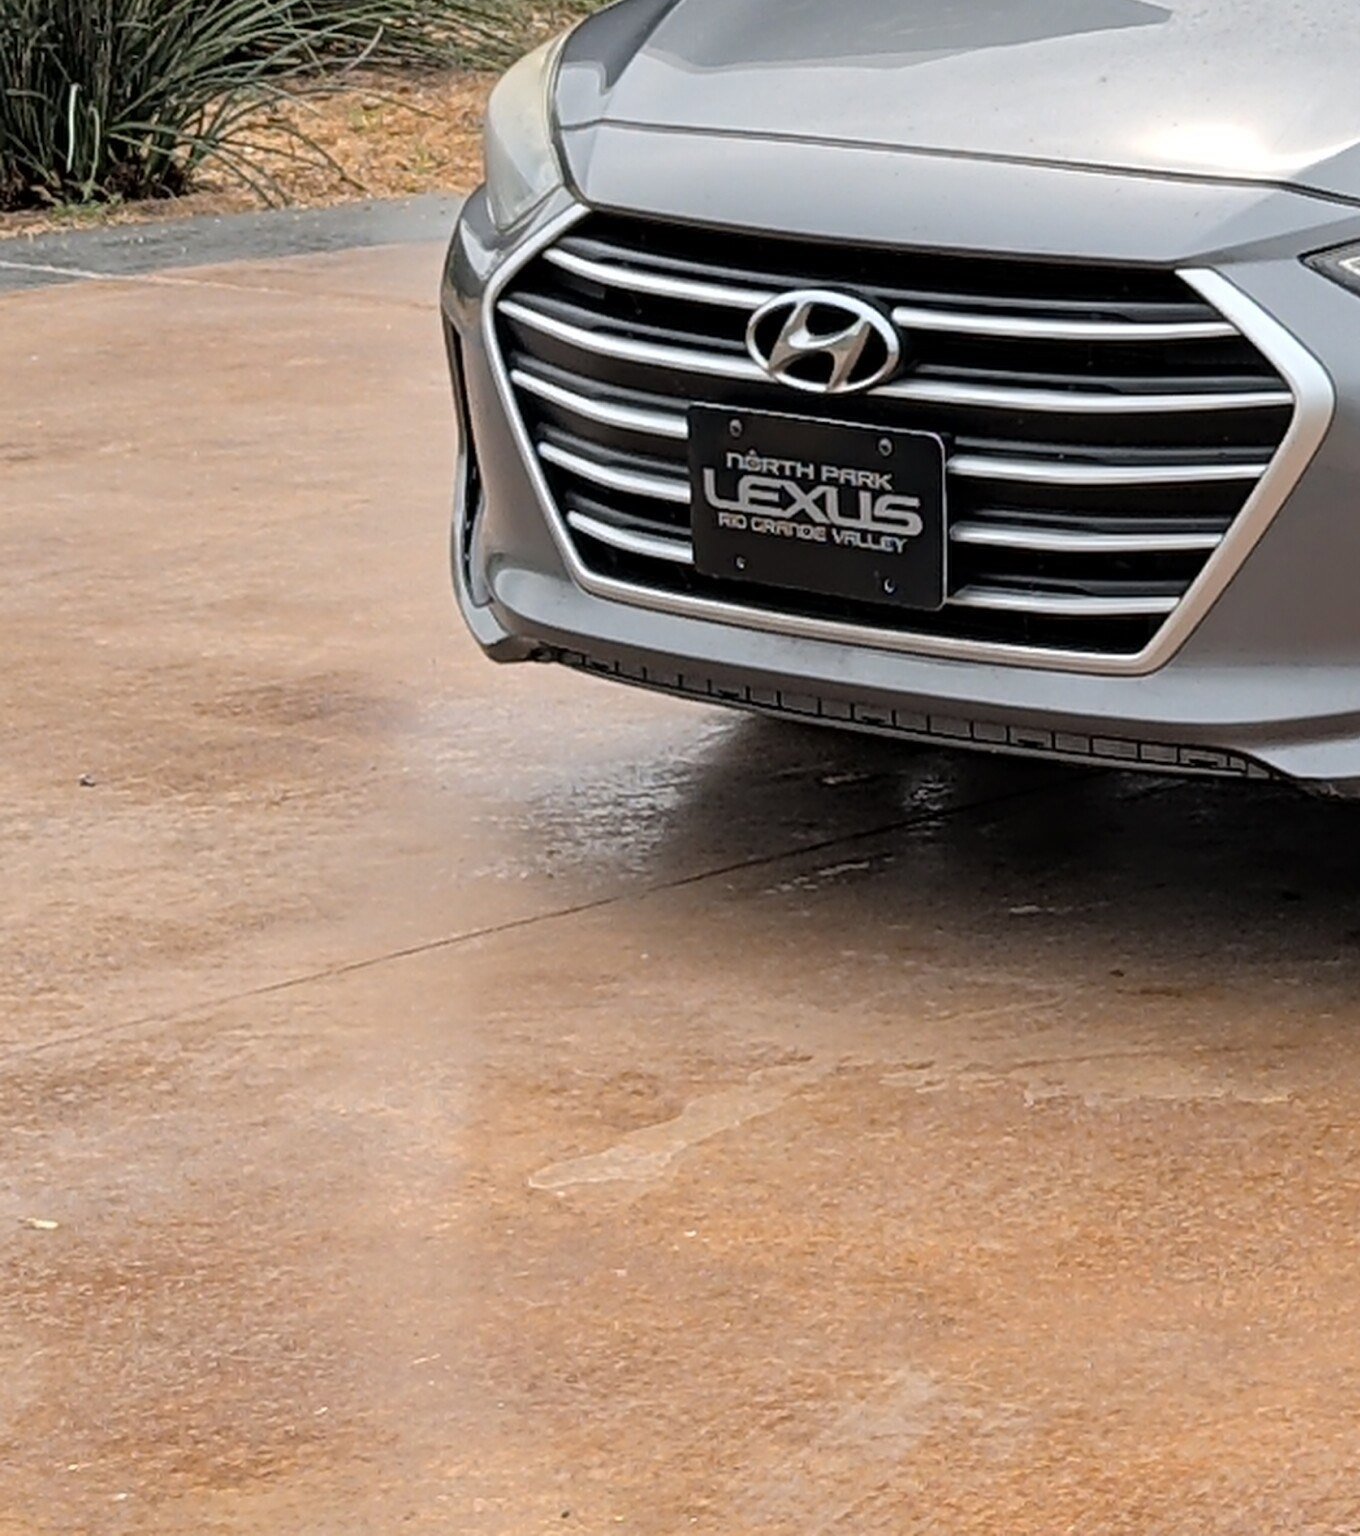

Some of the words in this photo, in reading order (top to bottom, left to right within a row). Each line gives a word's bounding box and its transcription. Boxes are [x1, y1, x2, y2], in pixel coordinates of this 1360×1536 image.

[726, 450, 815, 480] NORTH
[821, 465, 893, 492] PARK
[703, 468, 923, 537] LEXUS
[718, 512, 747, 531] RIO
[751, 516, 827, 544] GRANDE
[831, 527, 908, 554] VALLEY
